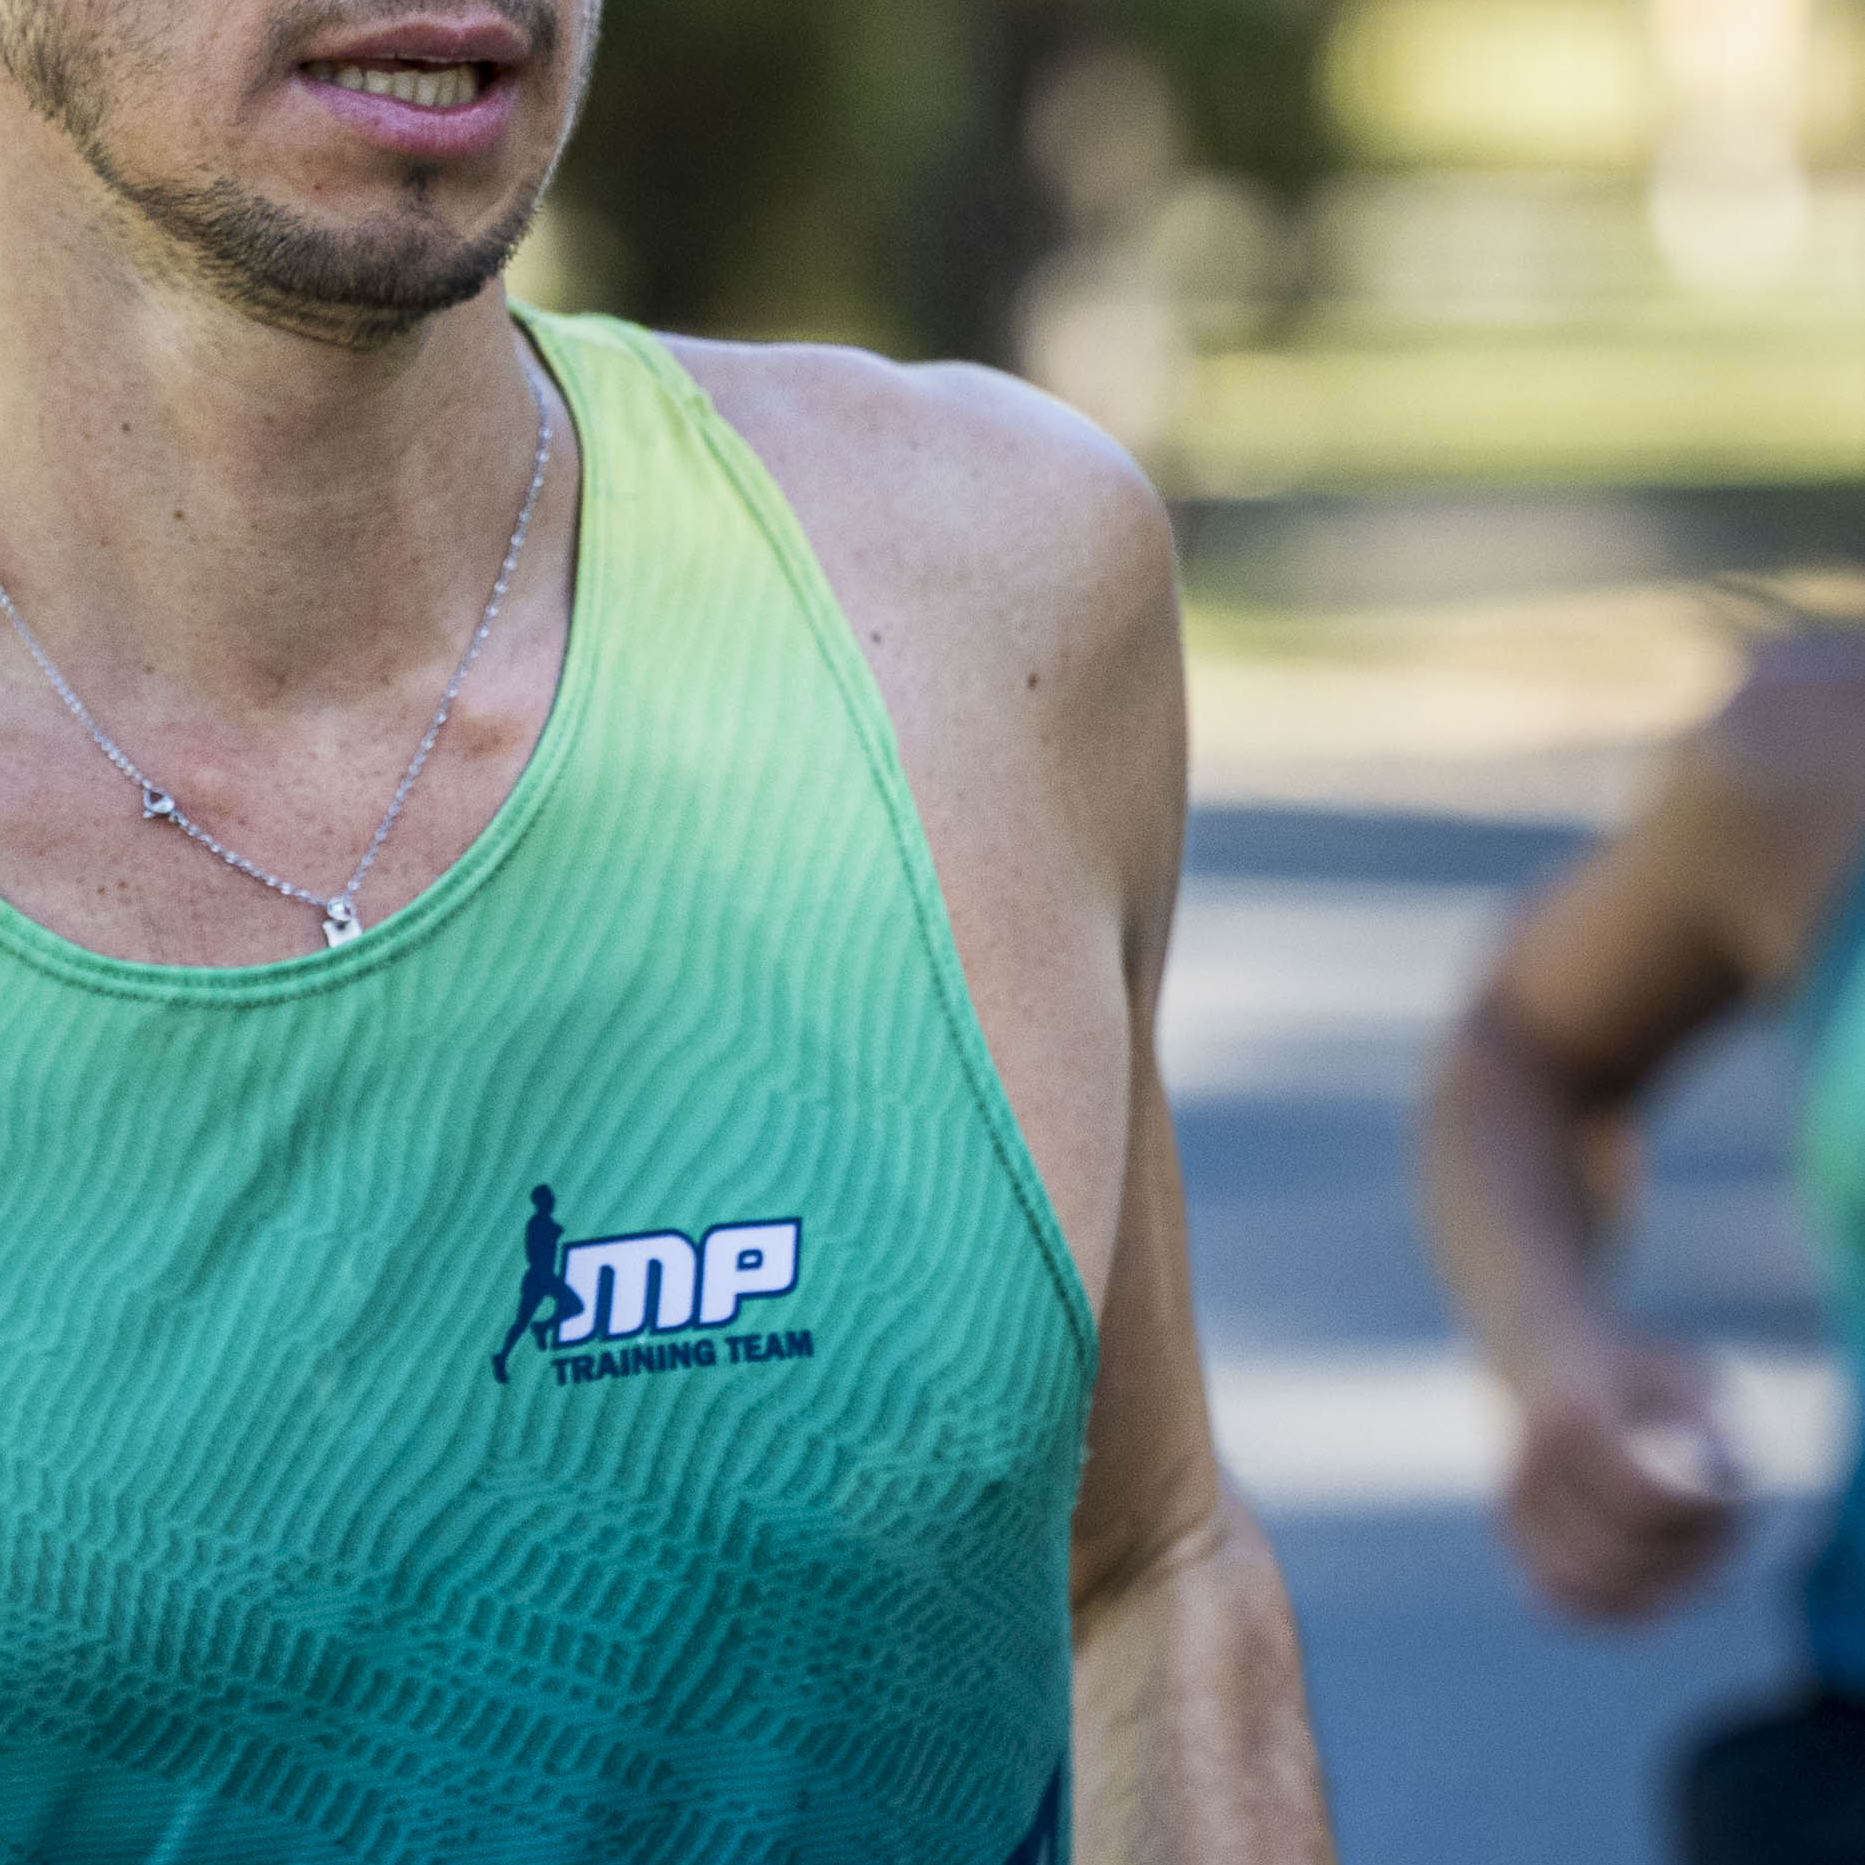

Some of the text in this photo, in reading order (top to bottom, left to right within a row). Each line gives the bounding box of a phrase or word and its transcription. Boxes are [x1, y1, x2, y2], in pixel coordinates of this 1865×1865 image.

[556, 1218, 802, 1346] MP
[552, 1329, 814, 1386] TRAINING TEAM
